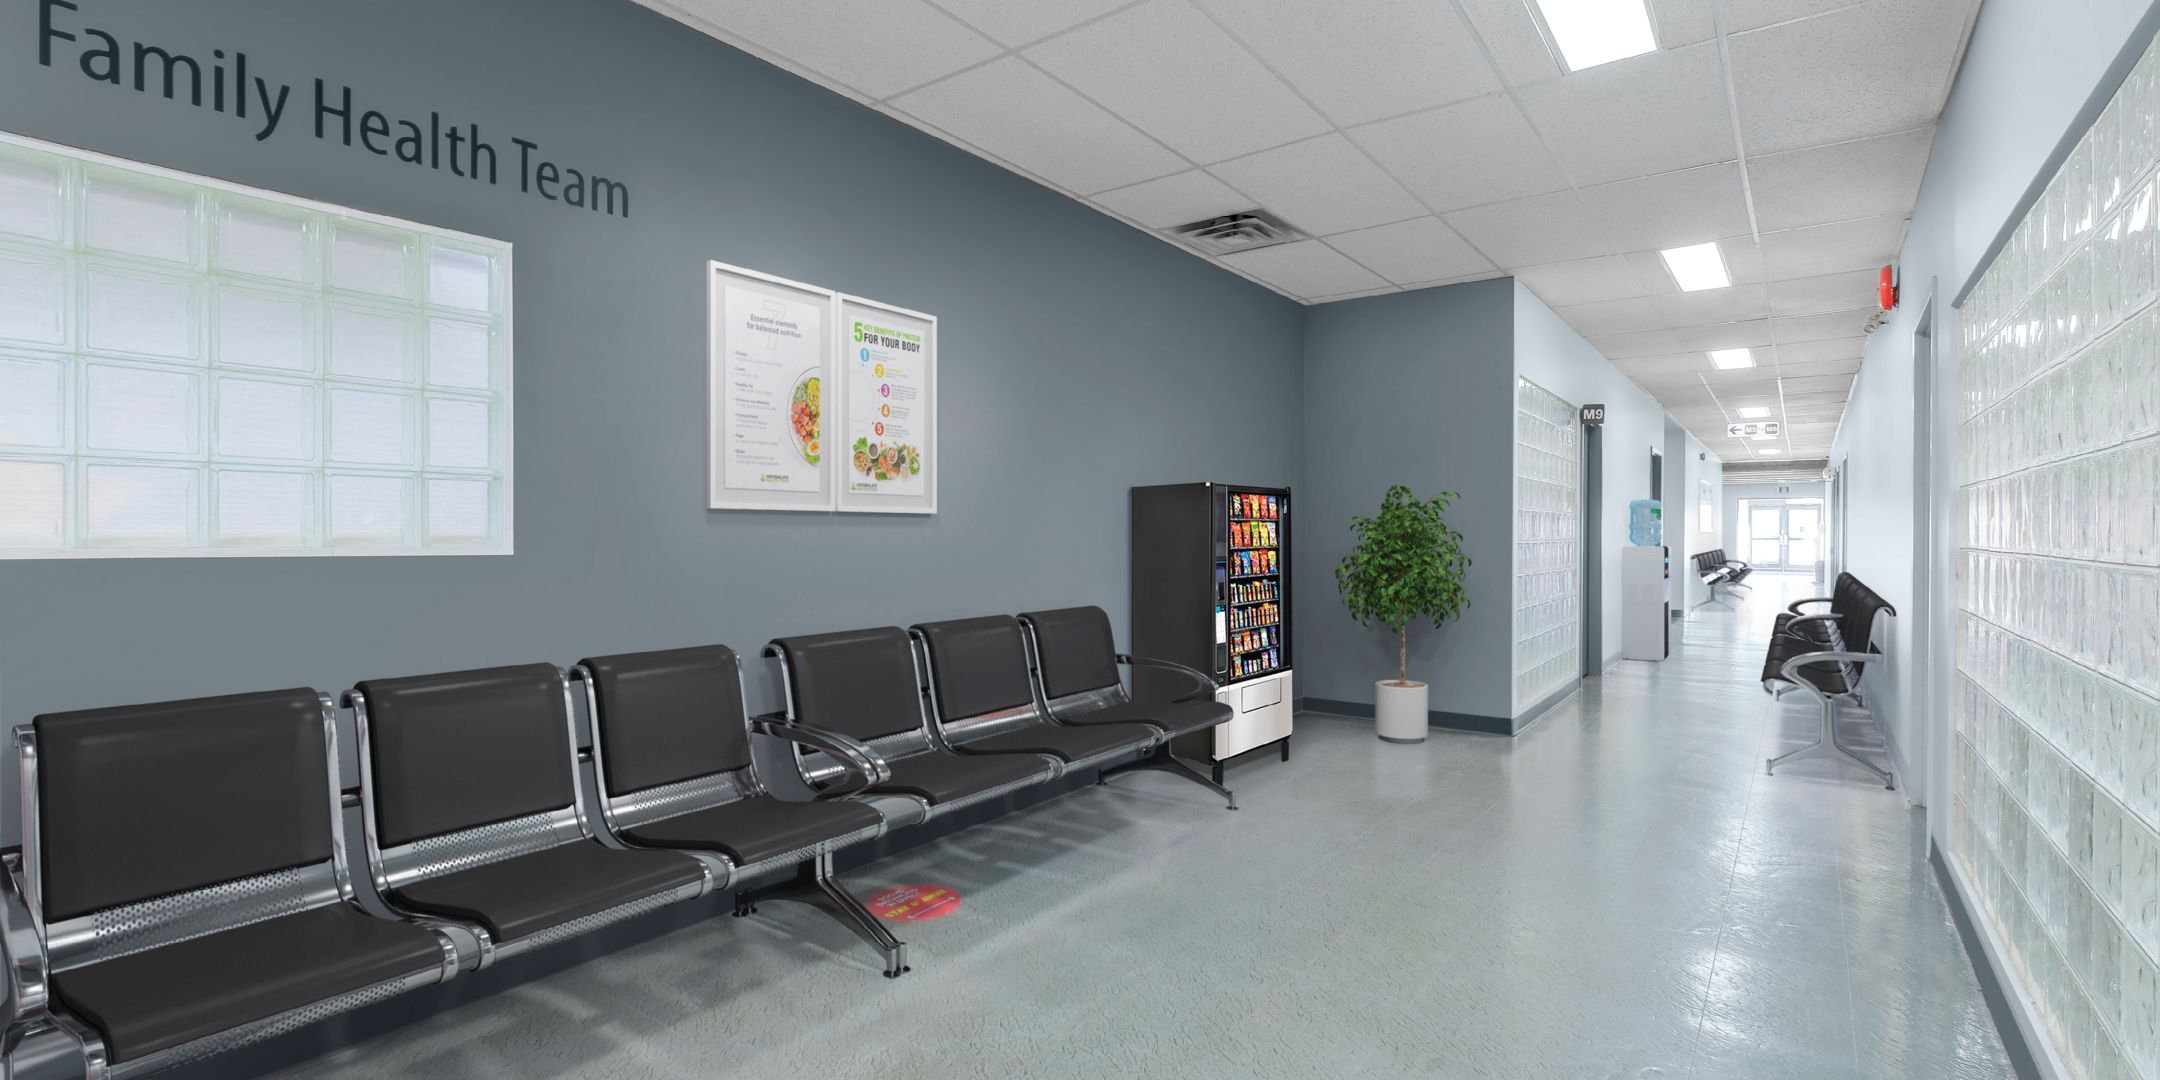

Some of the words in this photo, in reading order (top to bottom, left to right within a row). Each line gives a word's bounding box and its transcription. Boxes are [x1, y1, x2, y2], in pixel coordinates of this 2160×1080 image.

[37, 0, 290, 142] Family
[313, 77, 498, 185] Health
[511, 137, 630, 218] Team
[746, 321, 754, 330] for
[755, 323, 779, 335] balanced
[780, 329, 801, 339] nutrition
[750, 313, 774, 325] Essential
[775, 319, 798, 330] elements
[854, 321, 863, 342] 5
[864, 324, 873, 332] KEY
[874, 326, 895, 337] BENEFITS
[903, 332, 921, 342] PROTEIN
[864, 332, 878, 345] FOR
[880, 336, 900, 349] YOUR
[902, 340, 920, 353] BODY
[1583, 408, 1604, 420] M9
[877, 889, 905, 901] SOCIAL
[884, 904, 910, 918] STAY
